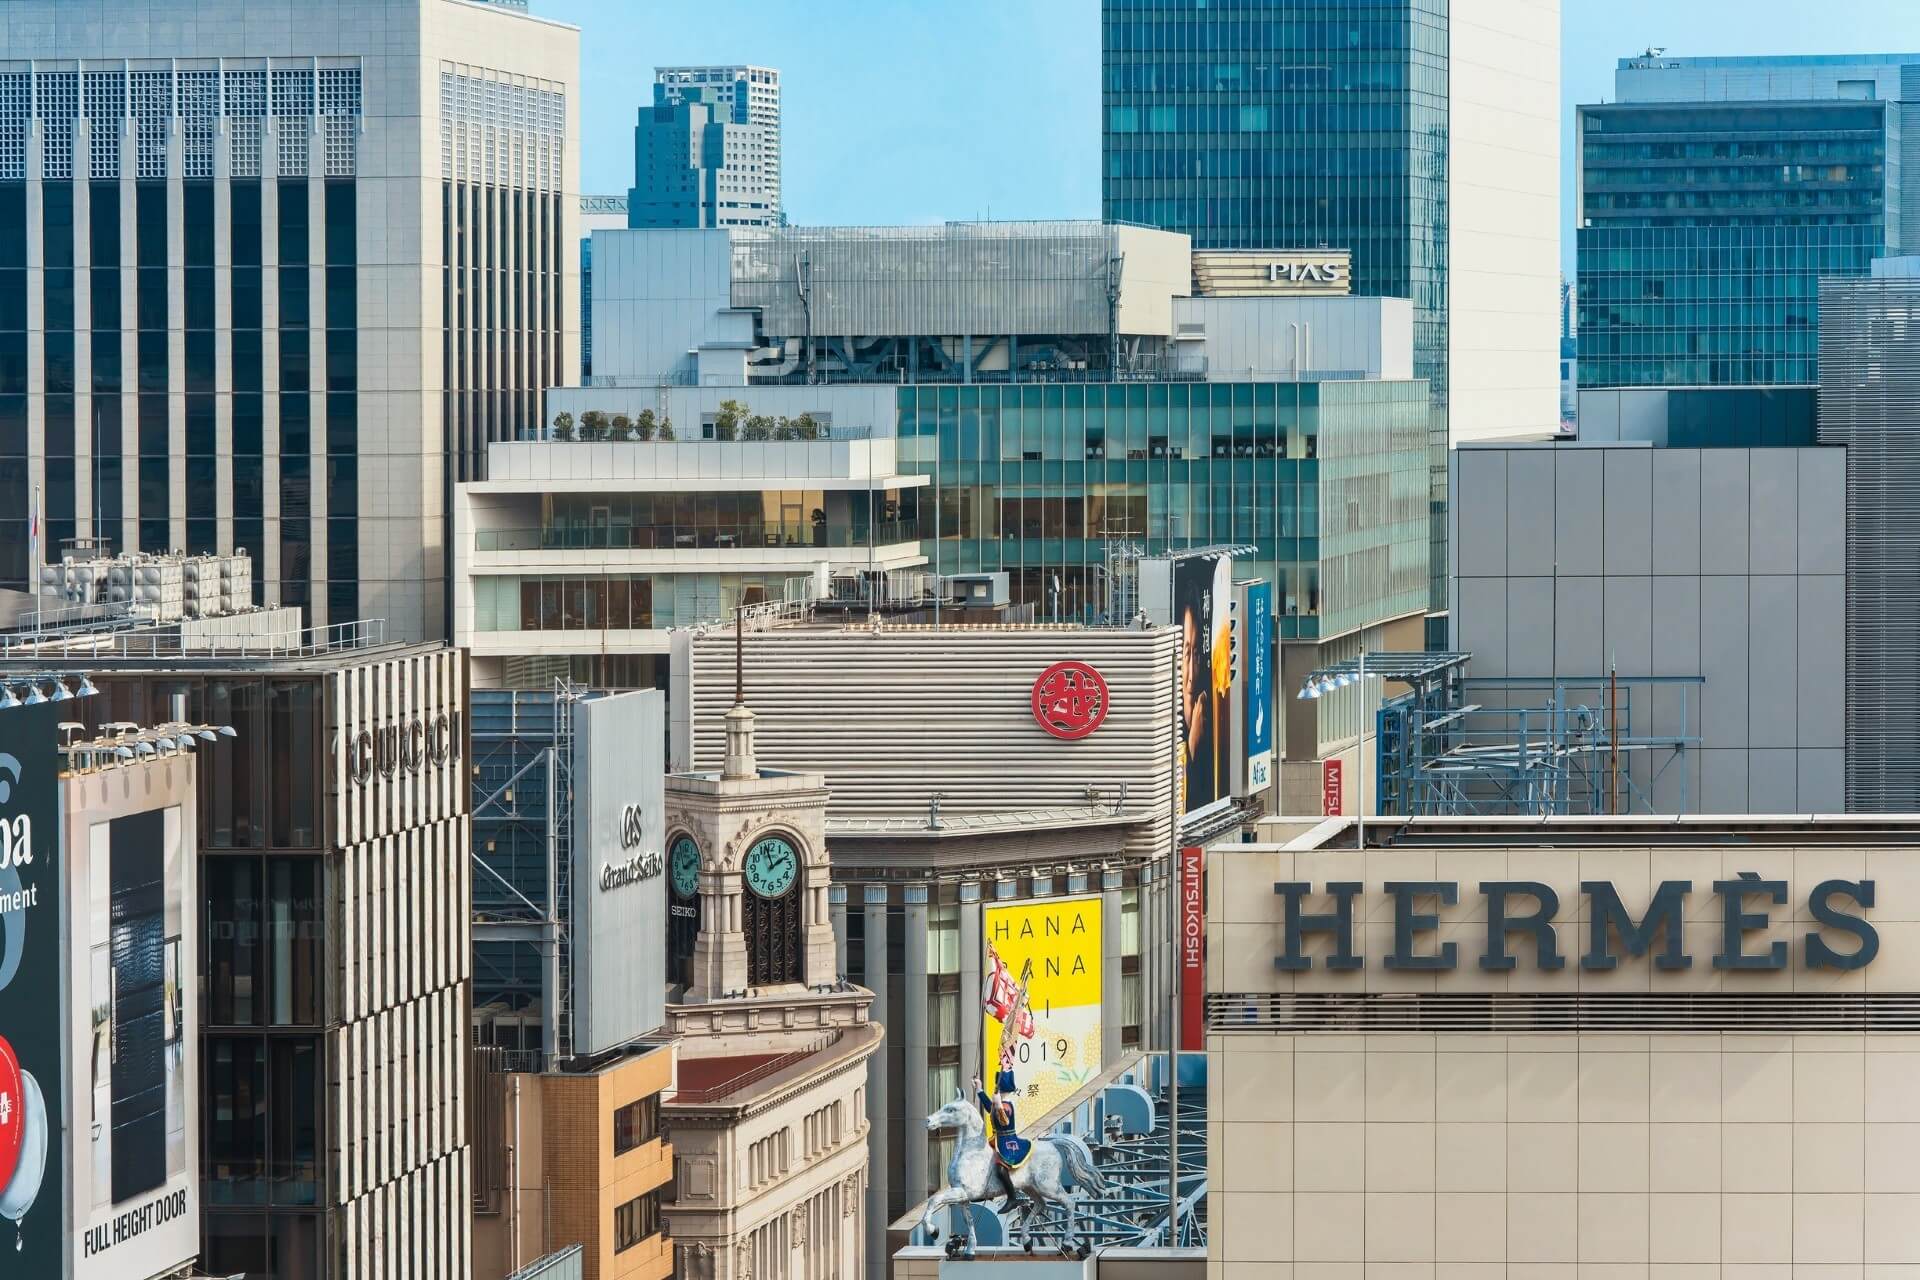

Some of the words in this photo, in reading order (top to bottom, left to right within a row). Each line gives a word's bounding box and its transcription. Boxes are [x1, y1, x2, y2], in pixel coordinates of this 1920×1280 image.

[1269, 262, 1340, 282] PIAS
[351, 711, 461, 785] GUCCI
[620, 804, 642, 850] GS
[752, 853, 760, 863] 10
[786, 861, 792, 870] 3
[600, 856, 635, 892] Grand
[633, 850, 663, 882] Seiko
[750, 864, 756, 873] 9
[753, 873, 759, 882] 8
[783, 871, 789, 880] 4
[760, 880, 767, 889] 7
[768, 882, 774, 891] 6
[776, 879, 782, 888] 5
[671, 905, 697, 918] SEIKO
[1186, 856, 1199, 968] MITSUKOSHI
[1274, 871, 1880, 970] HERMÈS
[995, 913, 1085, 941] HANA
[1001, 954, 1085, 978] ANA
[1018, 1038, 1068, 1064] 019
[84, 1222, 111, 1259] FULL
[113, 1202, 154, 1246] HEIGHT
[155, 1188, 186, 1226] DOOR
